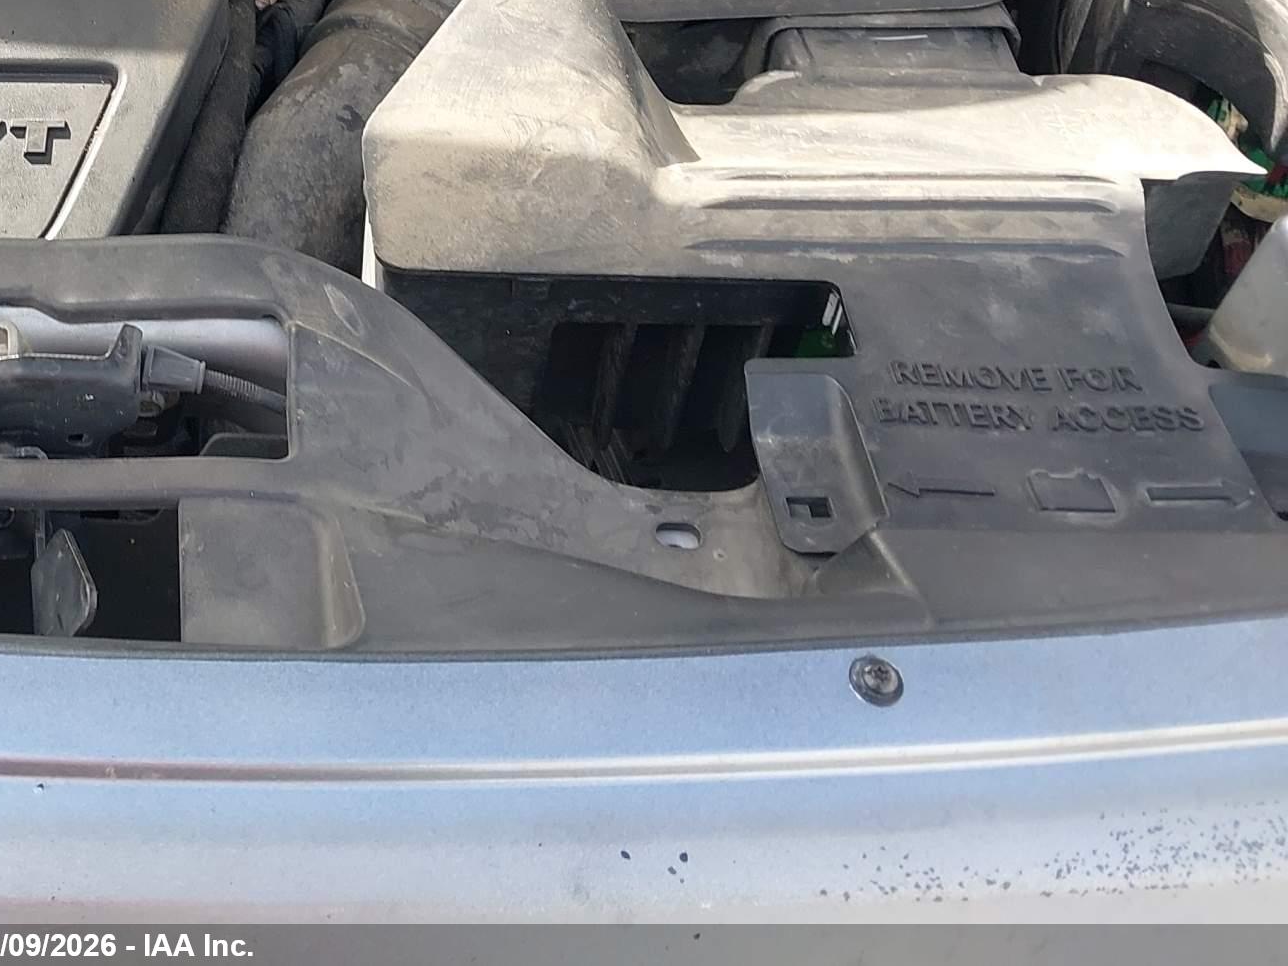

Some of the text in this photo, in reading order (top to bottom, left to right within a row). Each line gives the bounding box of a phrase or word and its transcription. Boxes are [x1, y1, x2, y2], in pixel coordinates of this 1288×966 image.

[888, 360, 1143, 392] REMOVE FOR
[873, 397, 1205, 432] BATTERY ACCESS
